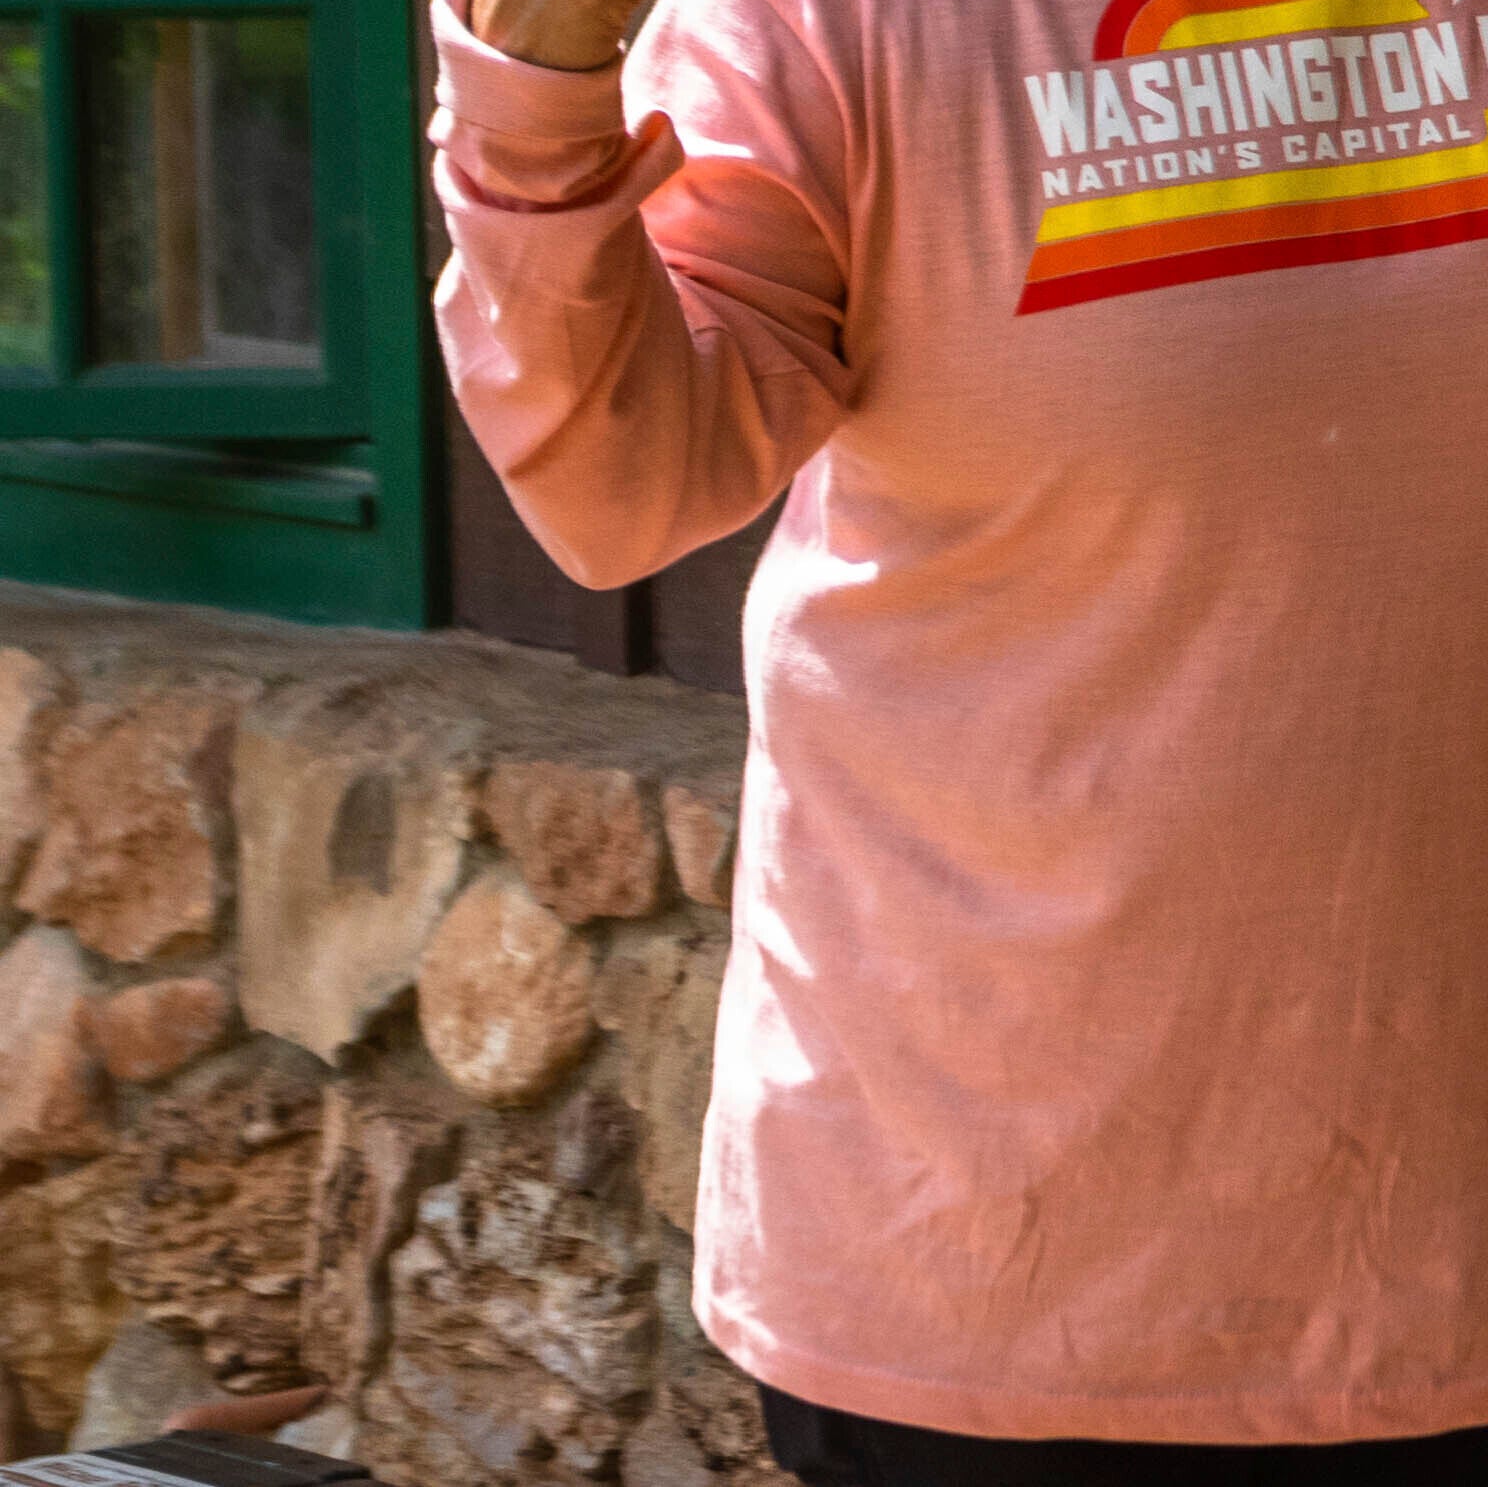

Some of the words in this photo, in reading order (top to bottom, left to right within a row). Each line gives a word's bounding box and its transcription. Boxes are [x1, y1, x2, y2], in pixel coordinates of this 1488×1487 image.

[1023, 20, 1470, 158] WASHINGTON
[1041, 140, 1262, 200] NATION'S
[1284, 112, 1471, 164] CAPITAL
